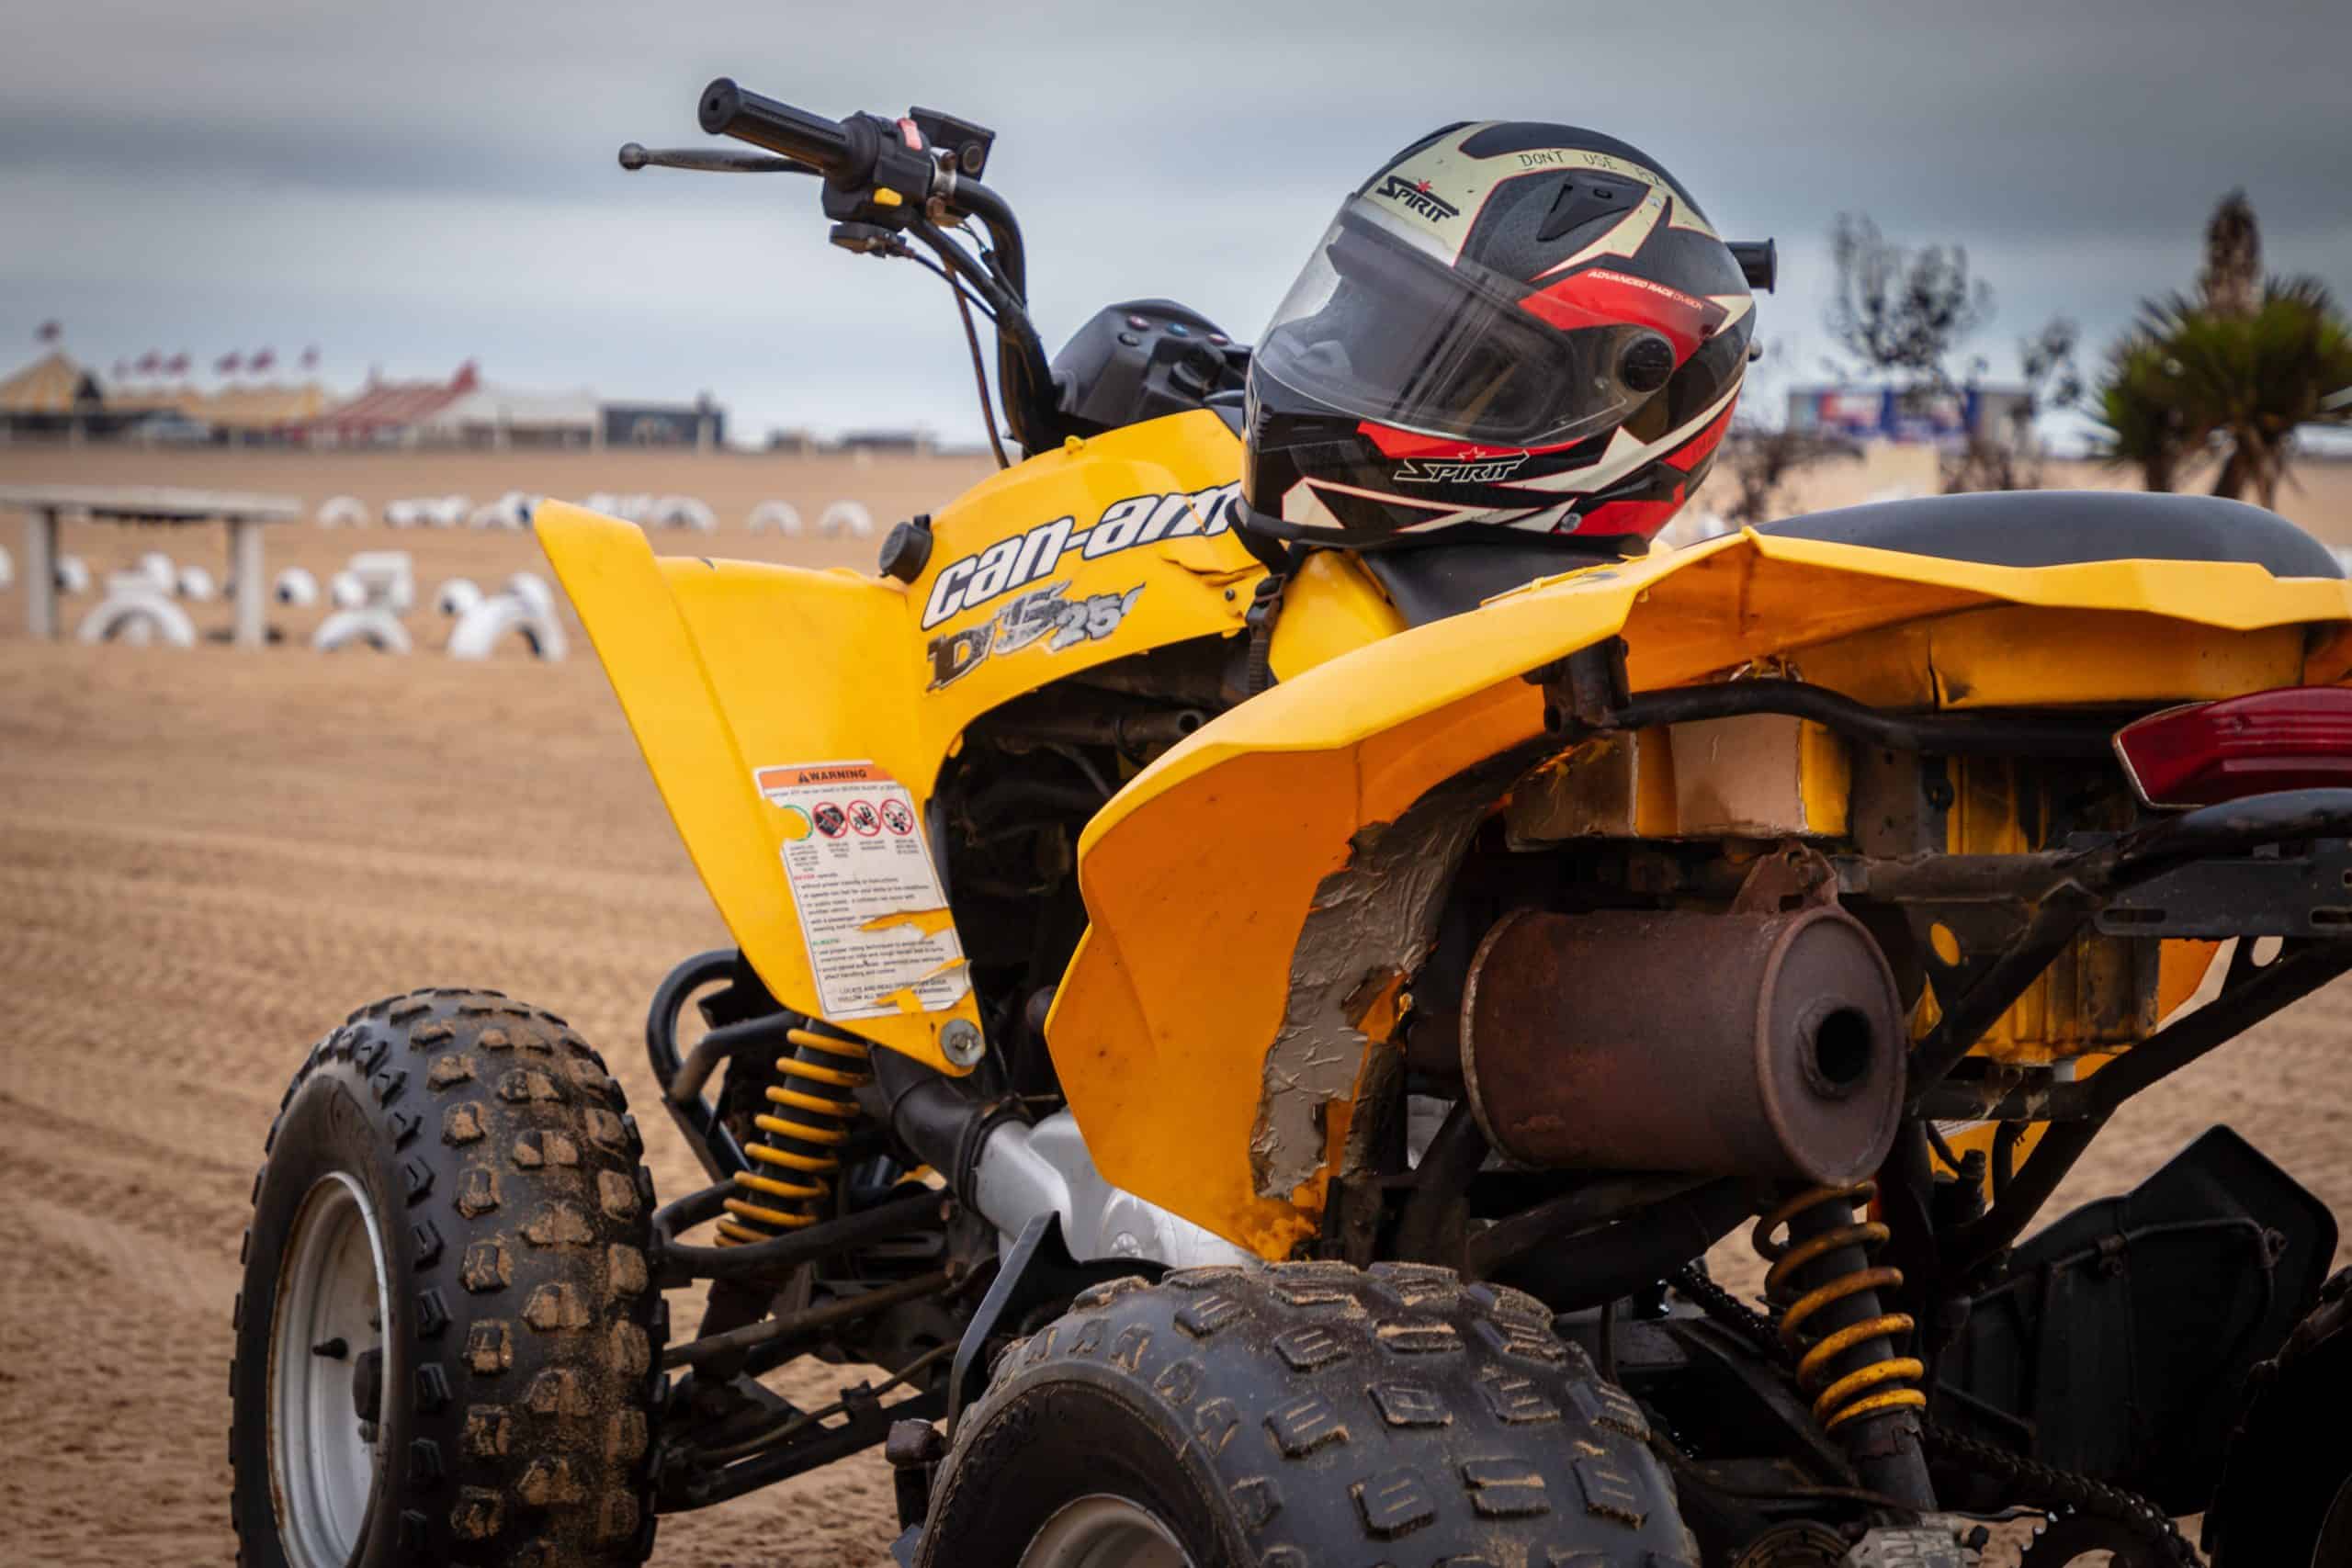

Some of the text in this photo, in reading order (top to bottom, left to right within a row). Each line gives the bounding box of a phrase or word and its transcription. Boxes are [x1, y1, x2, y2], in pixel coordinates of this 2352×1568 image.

[1375, 175, 1460, 222] SPIRIT
[1393, 448, 1530, 483] SPIRIT
[809, 769, 868, 781] WARNING
